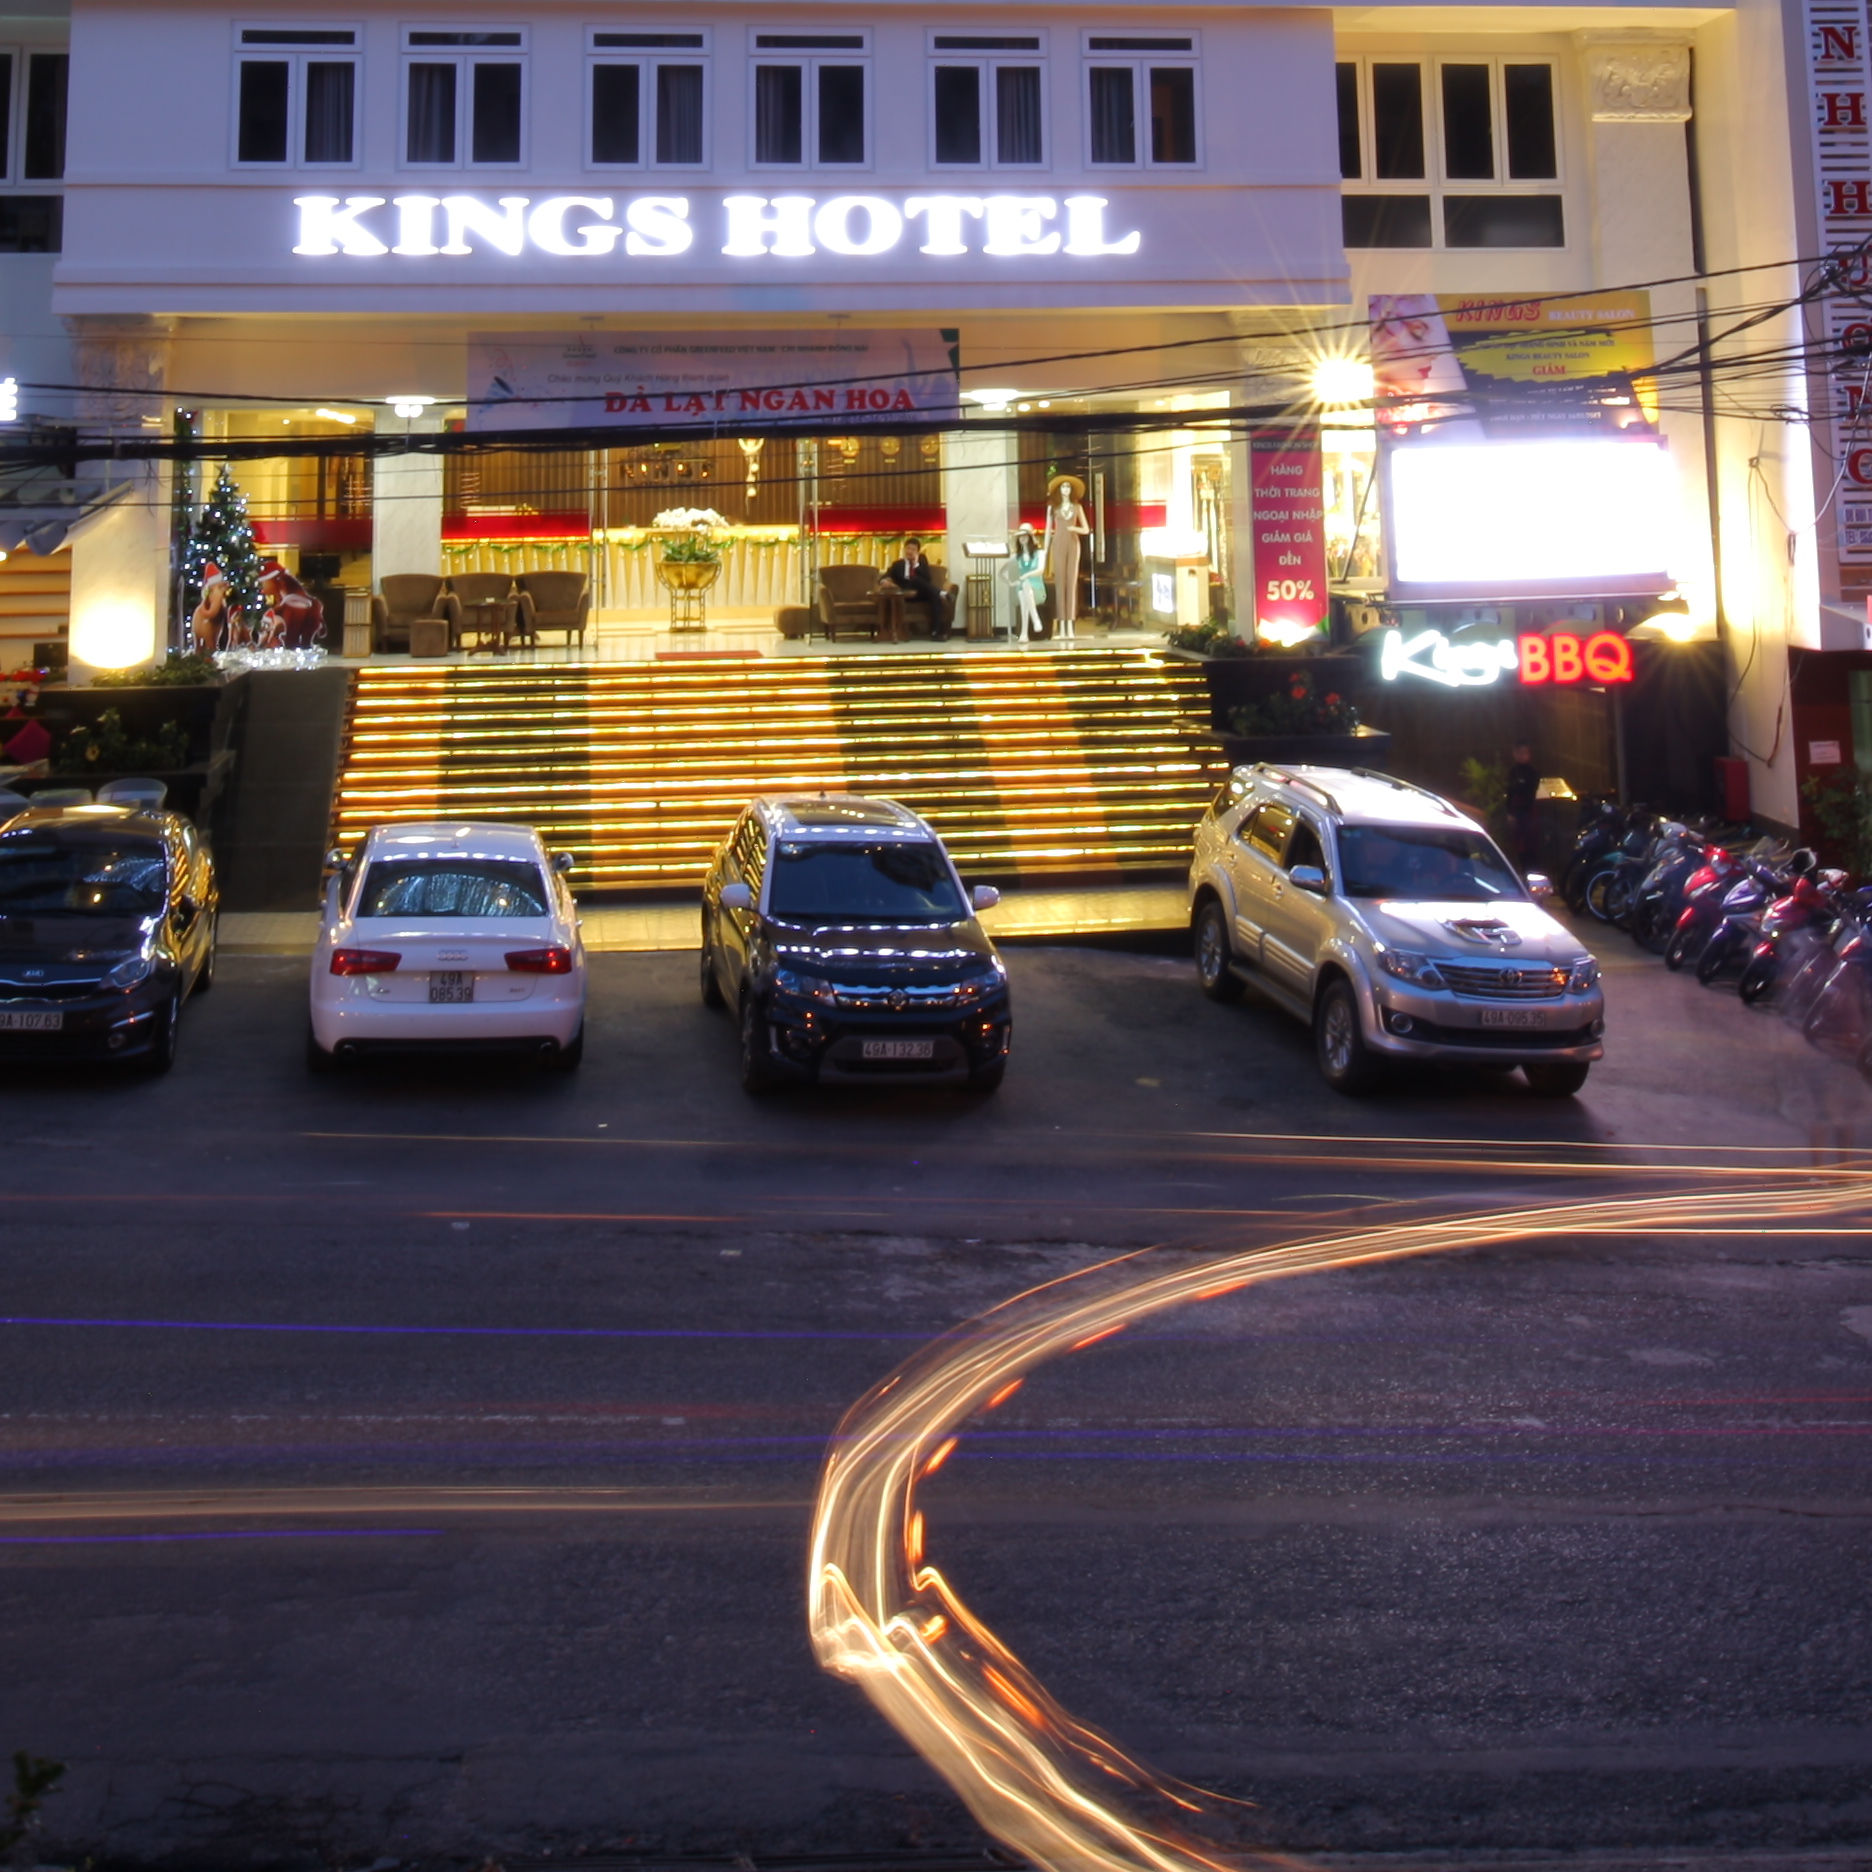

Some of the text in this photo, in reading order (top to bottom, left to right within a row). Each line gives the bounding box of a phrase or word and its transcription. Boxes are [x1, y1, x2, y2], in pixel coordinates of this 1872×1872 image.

[291, 194, 1141, 258] KINGS HOTEL
[1456, 299, 1636, 322] KINGS BEAUTY SALON
[1532, 362, 1566, 375] GIẢM
[604, 385, 652, 413] ĐÀ
[845, 388, 915, 411] HOA
[1271, 462, 1304, 476] HÀNG
[1254, 485, 1321, 498] THỜI TRANG
[1253, 507, 1323, 524] NGOẠI NHẬP
[1262, 529, 1313, 543] GIẢM GIÁ
[1278, 549, 1302, 566] ĐẾN
[1266, 579, 1315, 602] 50%
[1519, 630, 1635, 684] BBQ
[440, 971, 463, 986] 49A
